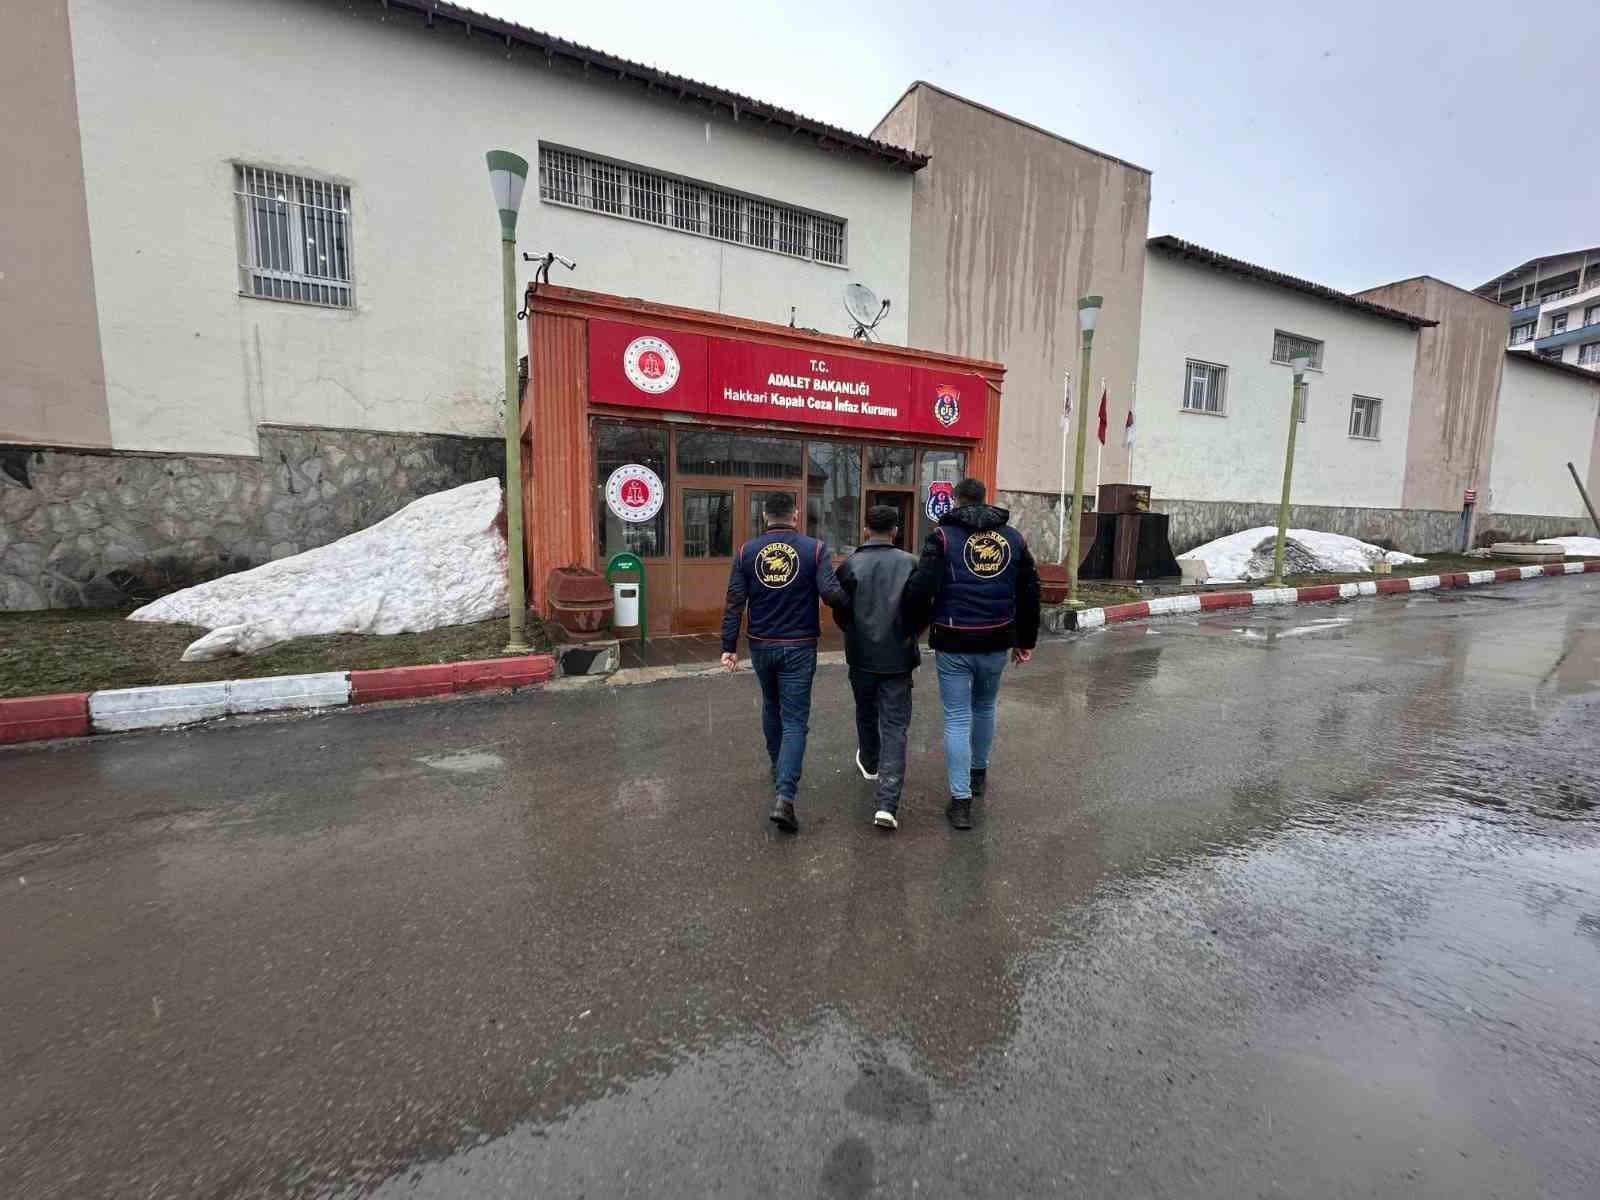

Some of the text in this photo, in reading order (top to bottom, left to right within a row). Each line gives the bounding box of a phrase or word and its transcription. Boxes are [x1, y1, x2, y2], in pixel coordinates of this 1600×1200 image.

[809, 359, 830, 373] T.C.
[767, 373, 870, 396] ADALET BAKANLIĞI
[723, 388, 898, 417] Hakkari Kapalı Ceza İnfaz Kurumu
[934, 502, 949, 514] CTE
